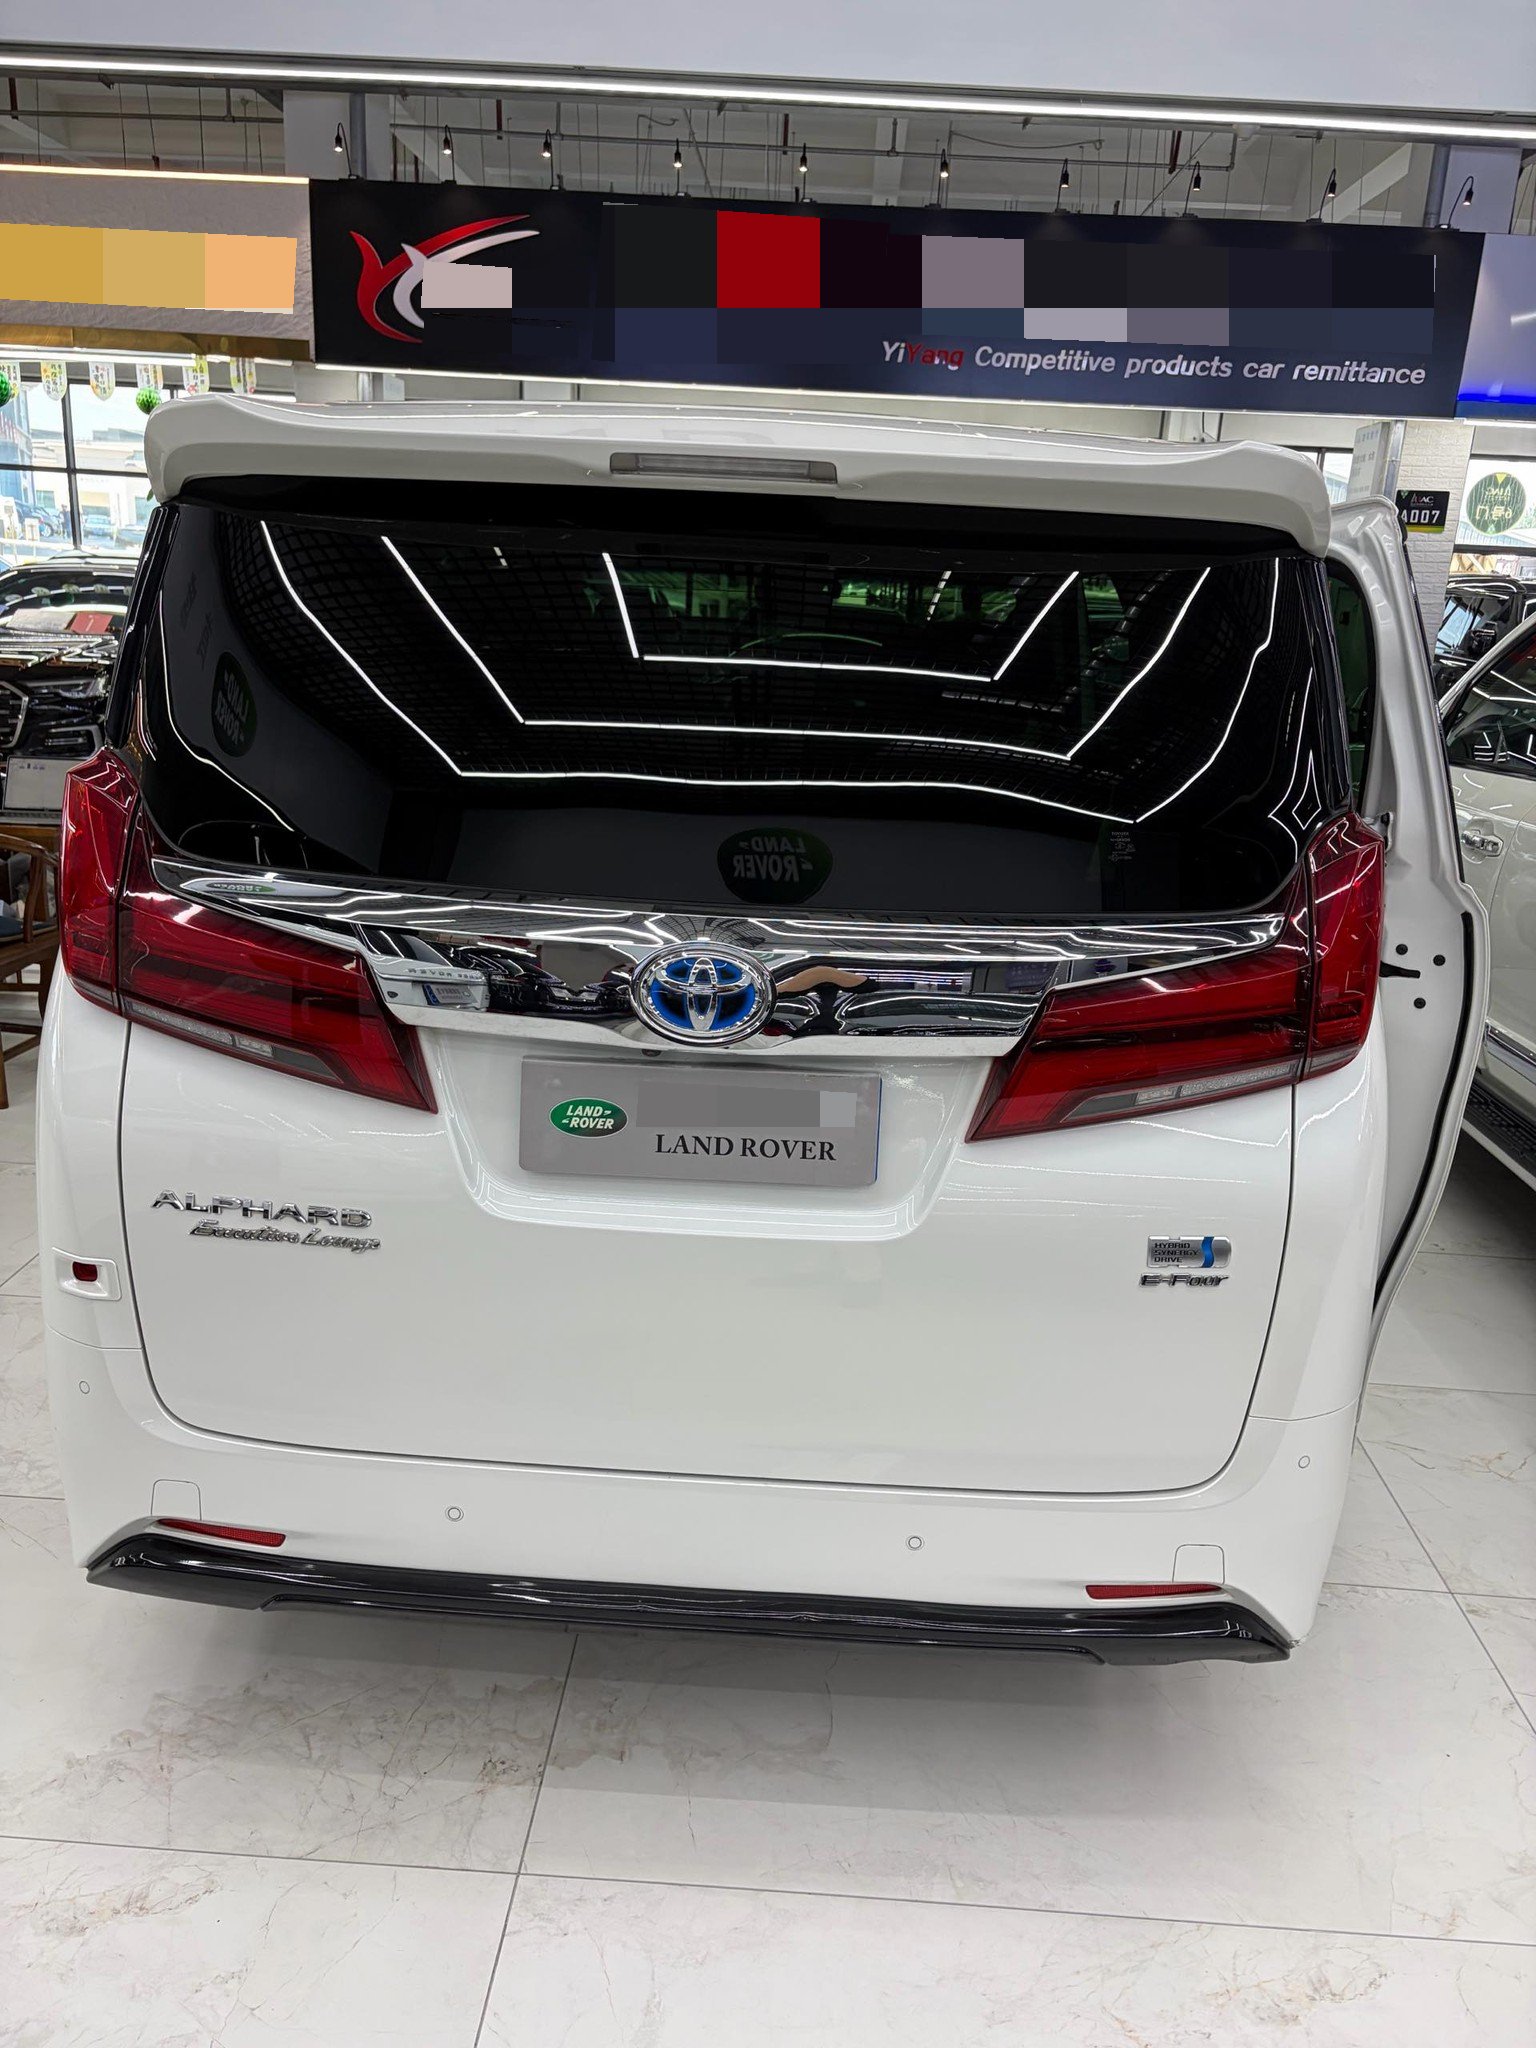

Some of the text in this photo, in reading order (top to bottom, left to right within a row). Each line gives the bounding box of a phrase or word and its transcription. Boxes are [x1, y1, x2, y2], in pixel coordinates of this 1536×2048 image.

[882, 341, 1427, 385] YiYang Competitive products car remittance
[566, 1104, 603, 1118] LAND
[569, 1117, 615, 1131] ROVER
[655, 1134, 837, 1162] LAND ROVER
[151, 1189, 373, 1229] ALPHARD
[189, 1218, 382, 1254] Executive Lounge
